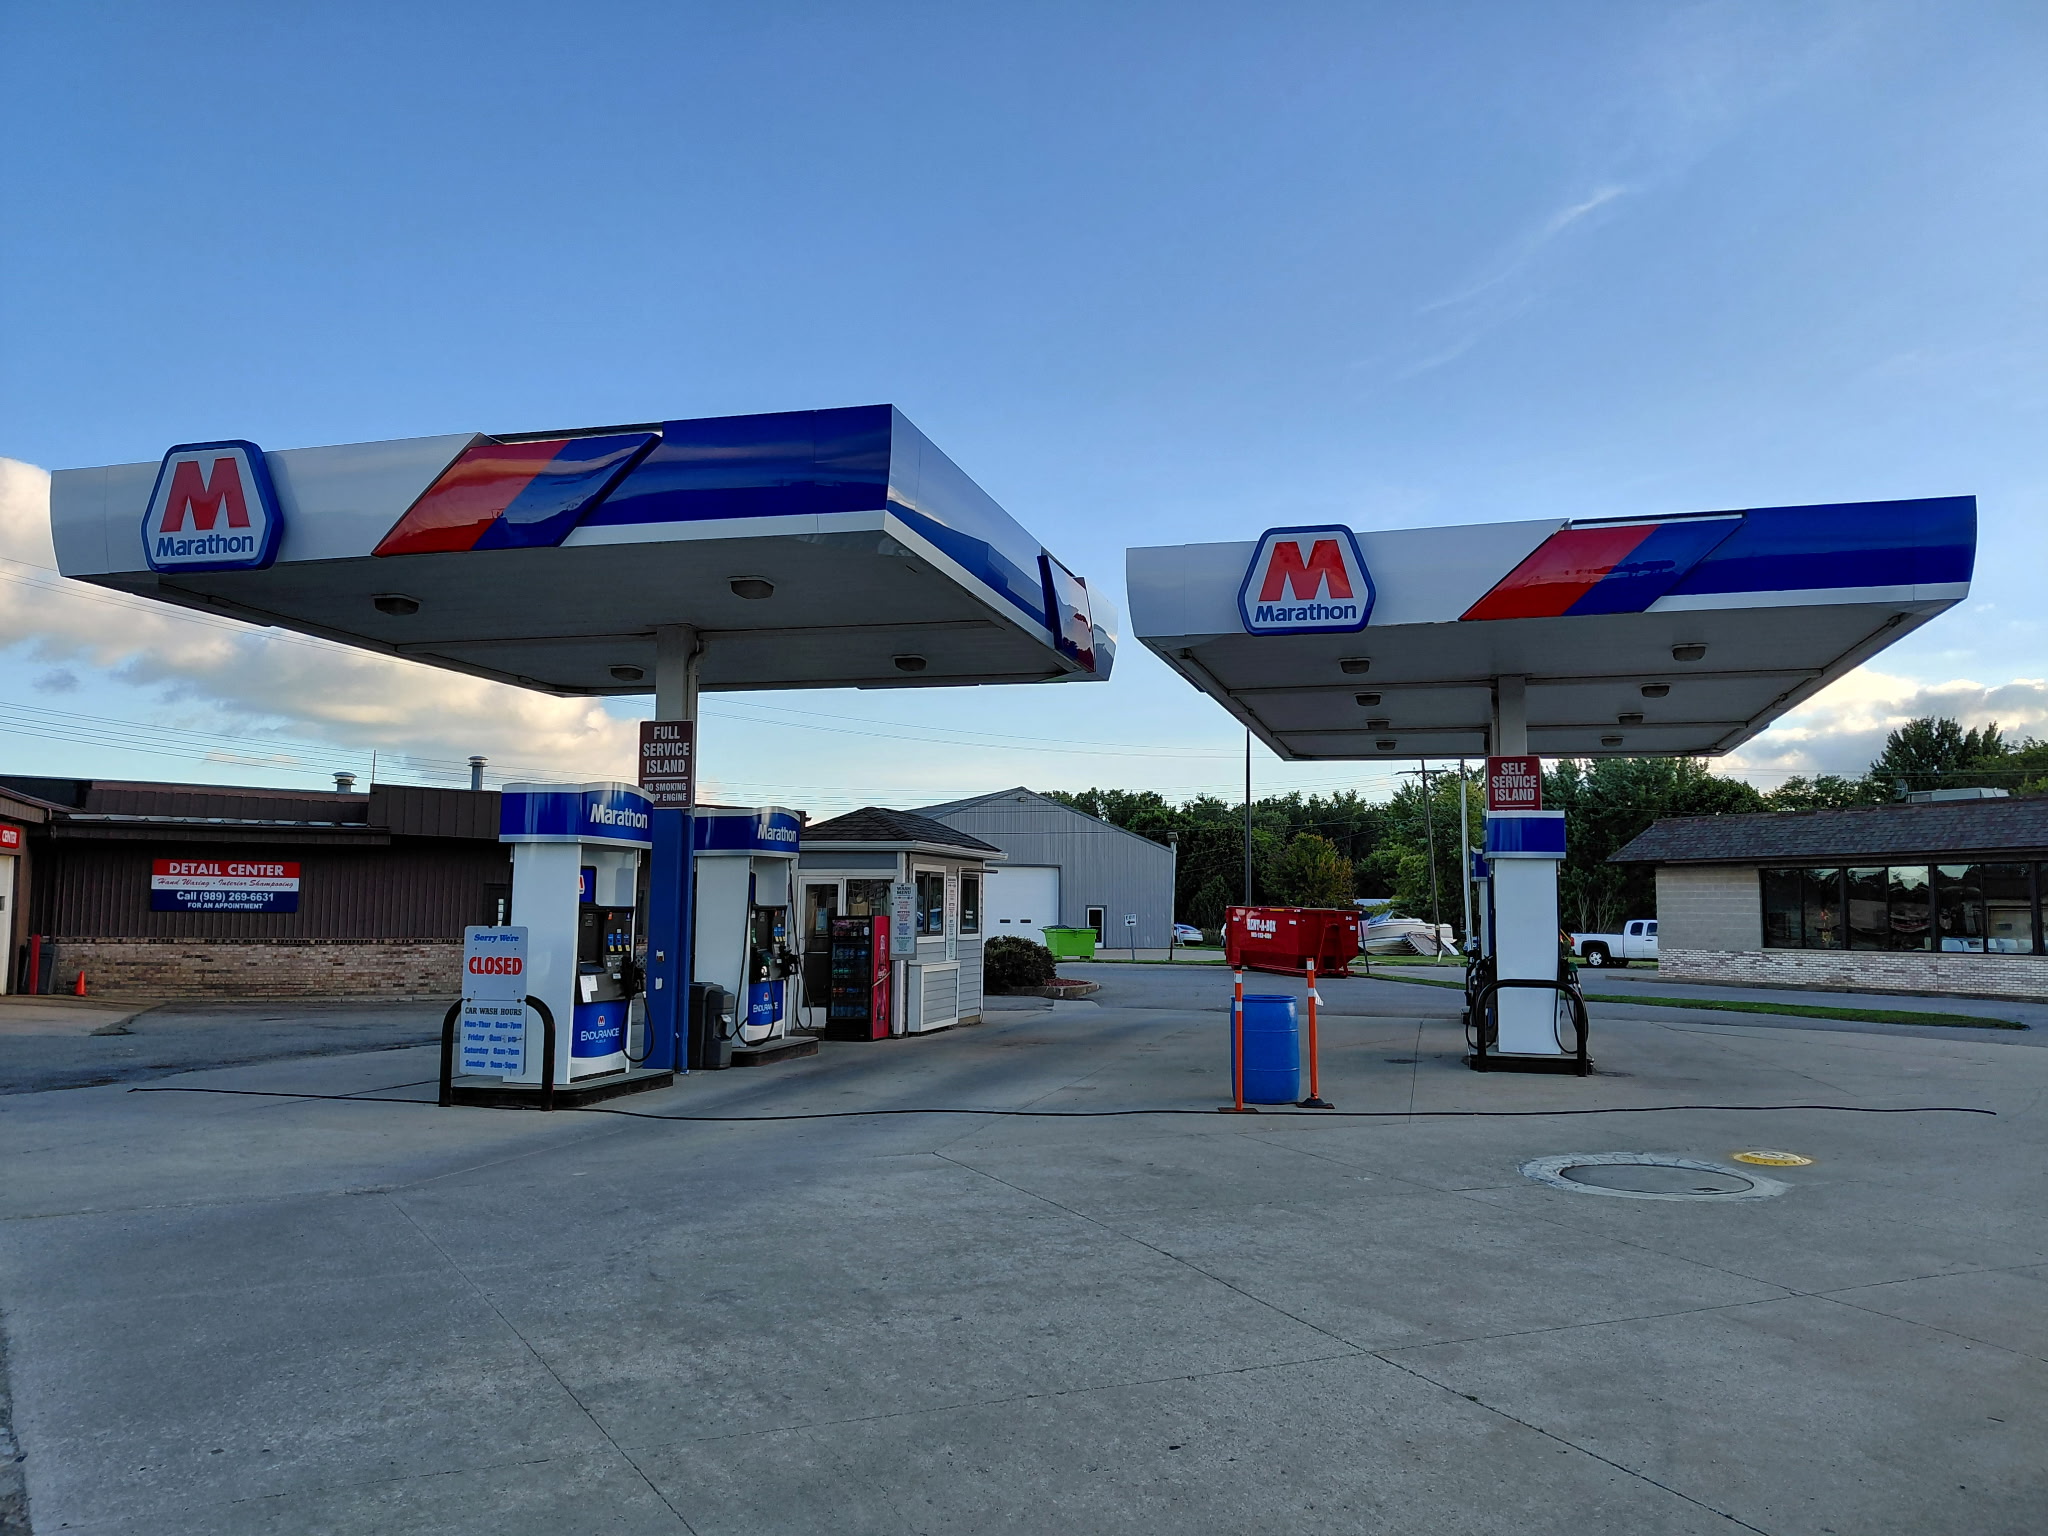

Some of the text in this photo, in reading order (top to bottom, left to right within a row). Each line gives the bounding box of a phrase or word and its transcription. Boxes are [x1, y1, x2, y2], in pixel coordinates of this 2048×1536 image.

[159, 457, 251, 533] M
[156, 534, 254, 557] Marathon
[1258, 539, 1354, 602] M
[1255, 604, 1357, 622] Marathon
[653, 726, 680, 740] FULL
[643, 742, 690, 757] SERVICE
[646, 759, 686, 774] ISLAND
[1501, 762, 1527, 775] SELF
[655, 782, 687, 792] SMOKING
[1492, 775, 1537, 789] SERVICE
[662, 793, 687, 802] ENGINE
[1494, 788, 1535, 801] ISLAND
[589, 803, 648, 829] Marathon
[757, 823, 797, 843] Marathon
[169, 862, 284, 876] DETAIL CENTER
[157, 878, 294, 889] Hand Waxing Interior Shampooing
[176, 891, 274, 903] Call (989) 269-6631
[214, 902, 263, 910] APPOINTMENT
[474, 933, 498, 943] Sorry
[468, 956, 523, 976] CLOSED
[465, 1007, 477, 1015] CAR
[501, 1008, 523, 1016] HOURS
[468, 1033, 485, 1042] Friday
[580, 1028, 620, 1041] ENDURANCE
[464, 1046, 489, 1055] Saturday
[466, 1059, 486, 1068] Sunday
